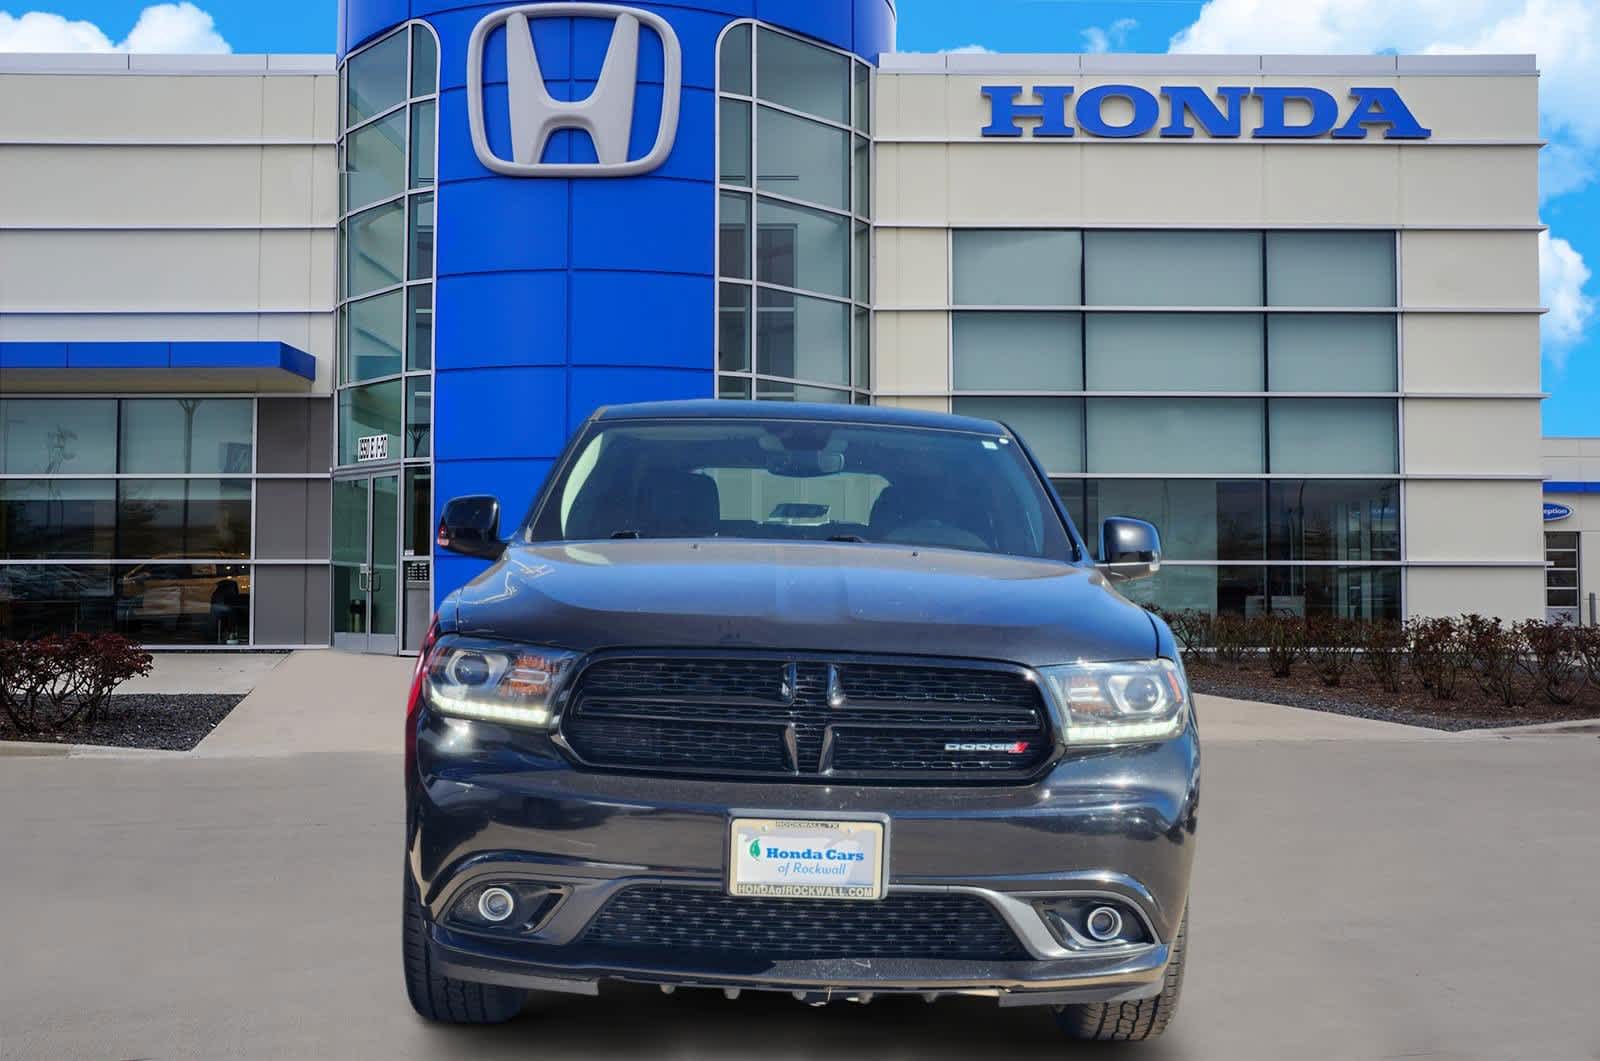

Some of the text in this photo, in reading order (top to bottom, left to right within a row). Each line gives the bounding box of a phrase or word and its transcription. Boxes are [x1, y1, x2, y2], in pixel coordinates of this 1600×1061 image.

[981, 84, 1432, 139] HONDA
[944, 743, 1016, 751] DODGE
[766, 847, 865, 861] Honda Cars
[777, 862, 847, 876] of Rockwall
